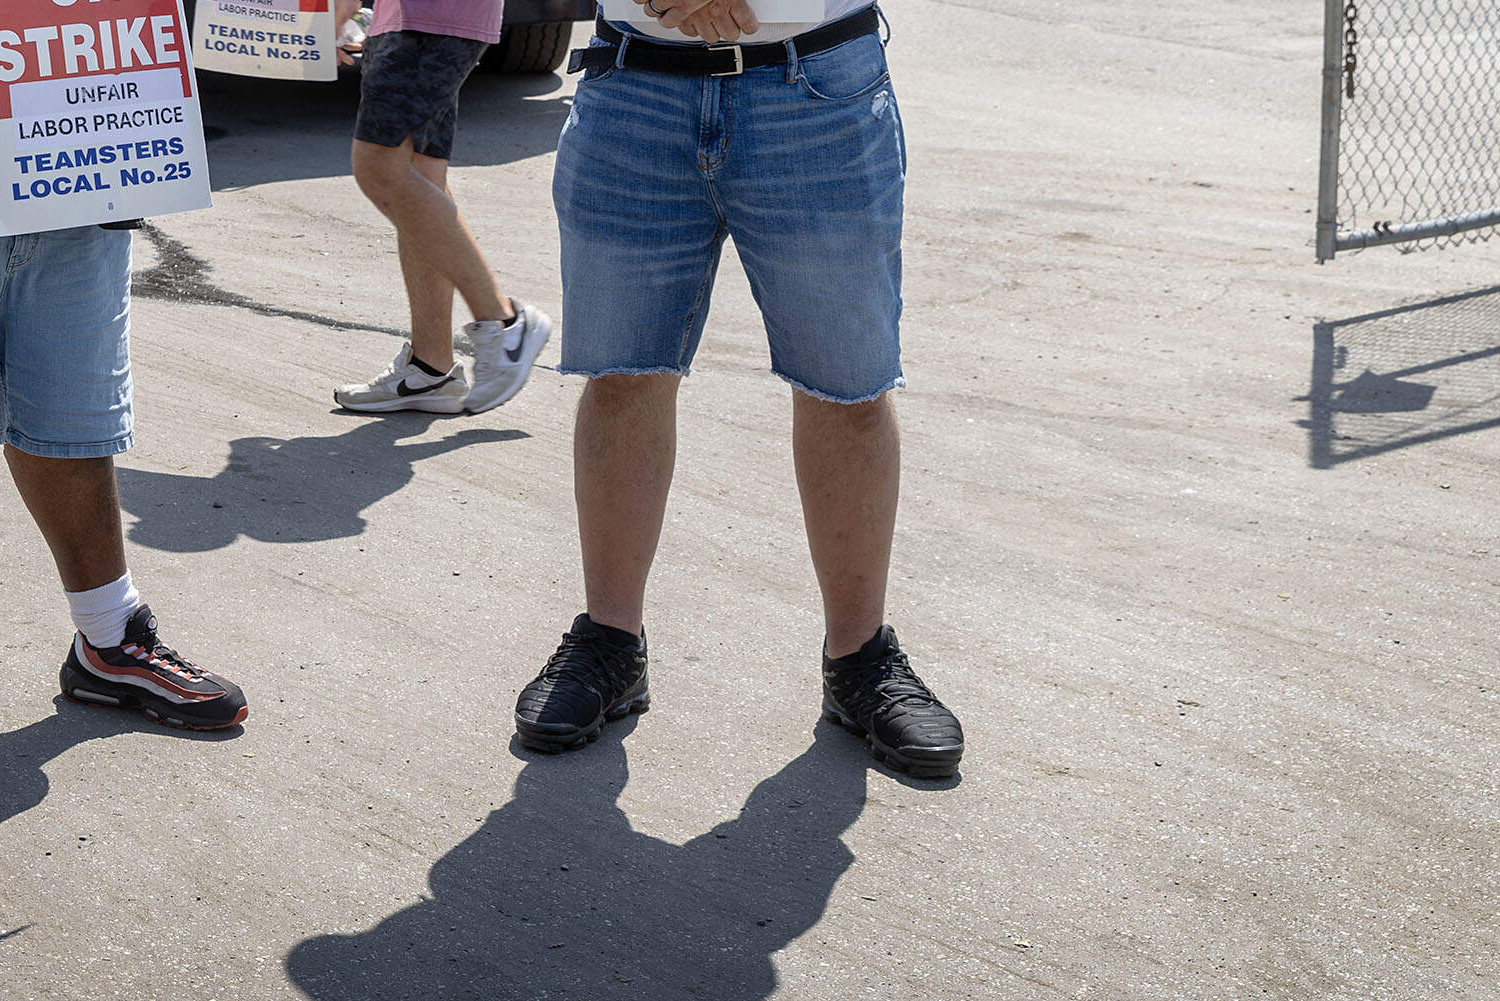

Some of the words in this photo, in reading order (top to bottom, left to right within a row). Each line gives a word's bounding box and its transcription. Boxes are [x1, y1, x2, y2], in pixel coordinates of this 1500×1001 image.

[219, 3, 247, 15] LABOR
[249, 8, 296, 22] PRACTICE
[208, 24, 316, 46] TEAMSTERS
[205, 39, 260, 56] LOCAL
[267, 47, 321, 61] No.25
[66, 82, 139, 105] UNFAIR
[19, 111, 88, 139] LABOR
[93, 106, 183, 133] PRACTICE
[14, 137, 184, 174] TEAMSTERS
[12, 172, 110, 200] LOCAL
[120, 161, 192, 188] No.25
